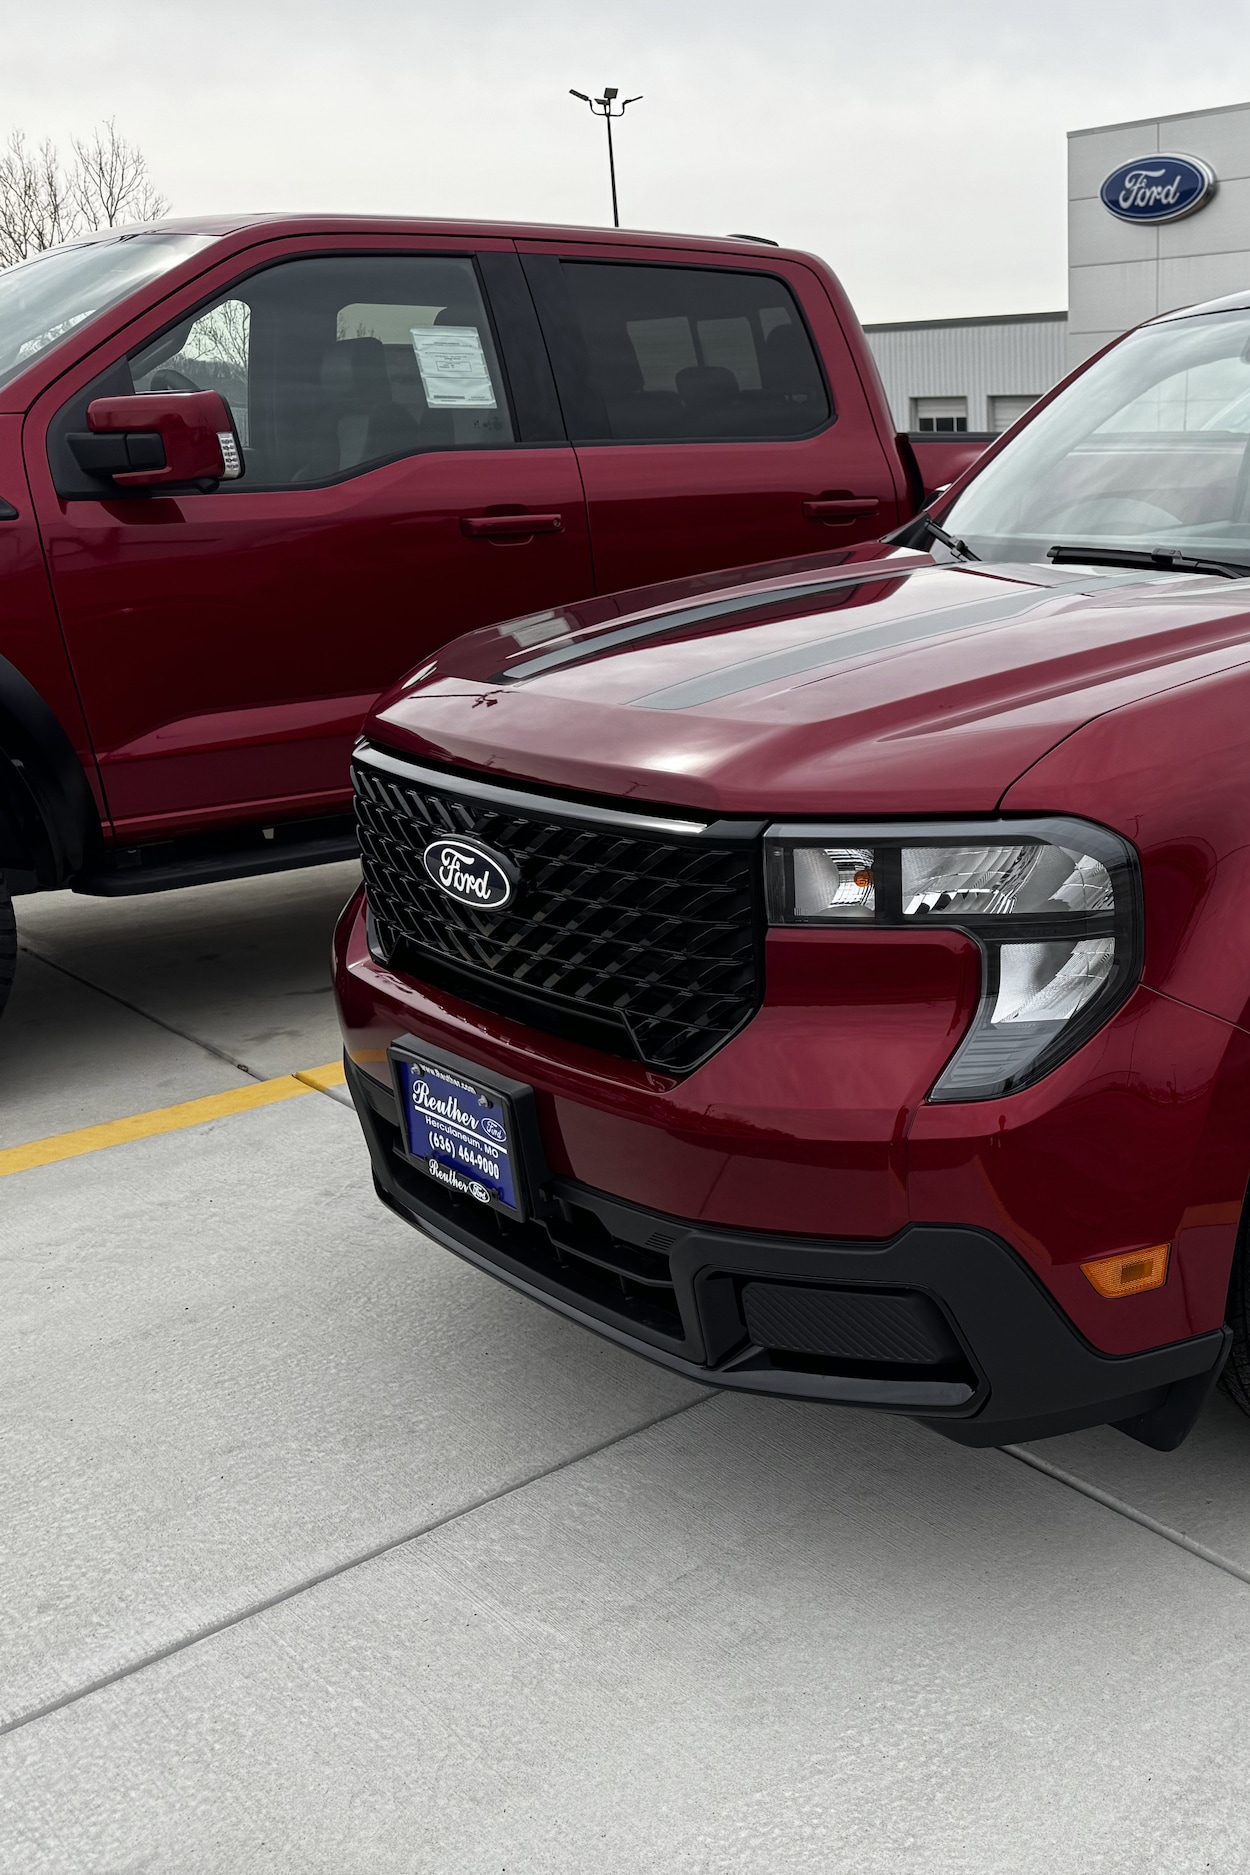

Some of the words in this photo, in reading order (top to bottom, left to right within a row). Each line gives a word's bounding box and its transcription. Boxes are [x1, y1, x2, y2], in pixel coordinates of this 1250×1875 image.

[1119, 169, 1181, 210] Ford
[439, 847, 491, 900] Ford
[412, 1080, 479, 1130] Reuther
[425, 1115, 483, 1150] Herculaneum,
[484, 1145, 499, 1159] MO
[486, 1121, 503, 1138] Ford
[428, 1131, 456, 1159] (636)
[458, 1144, 500, 1180] 464-9000
[428, 1158, 470, 1193] Reuther
